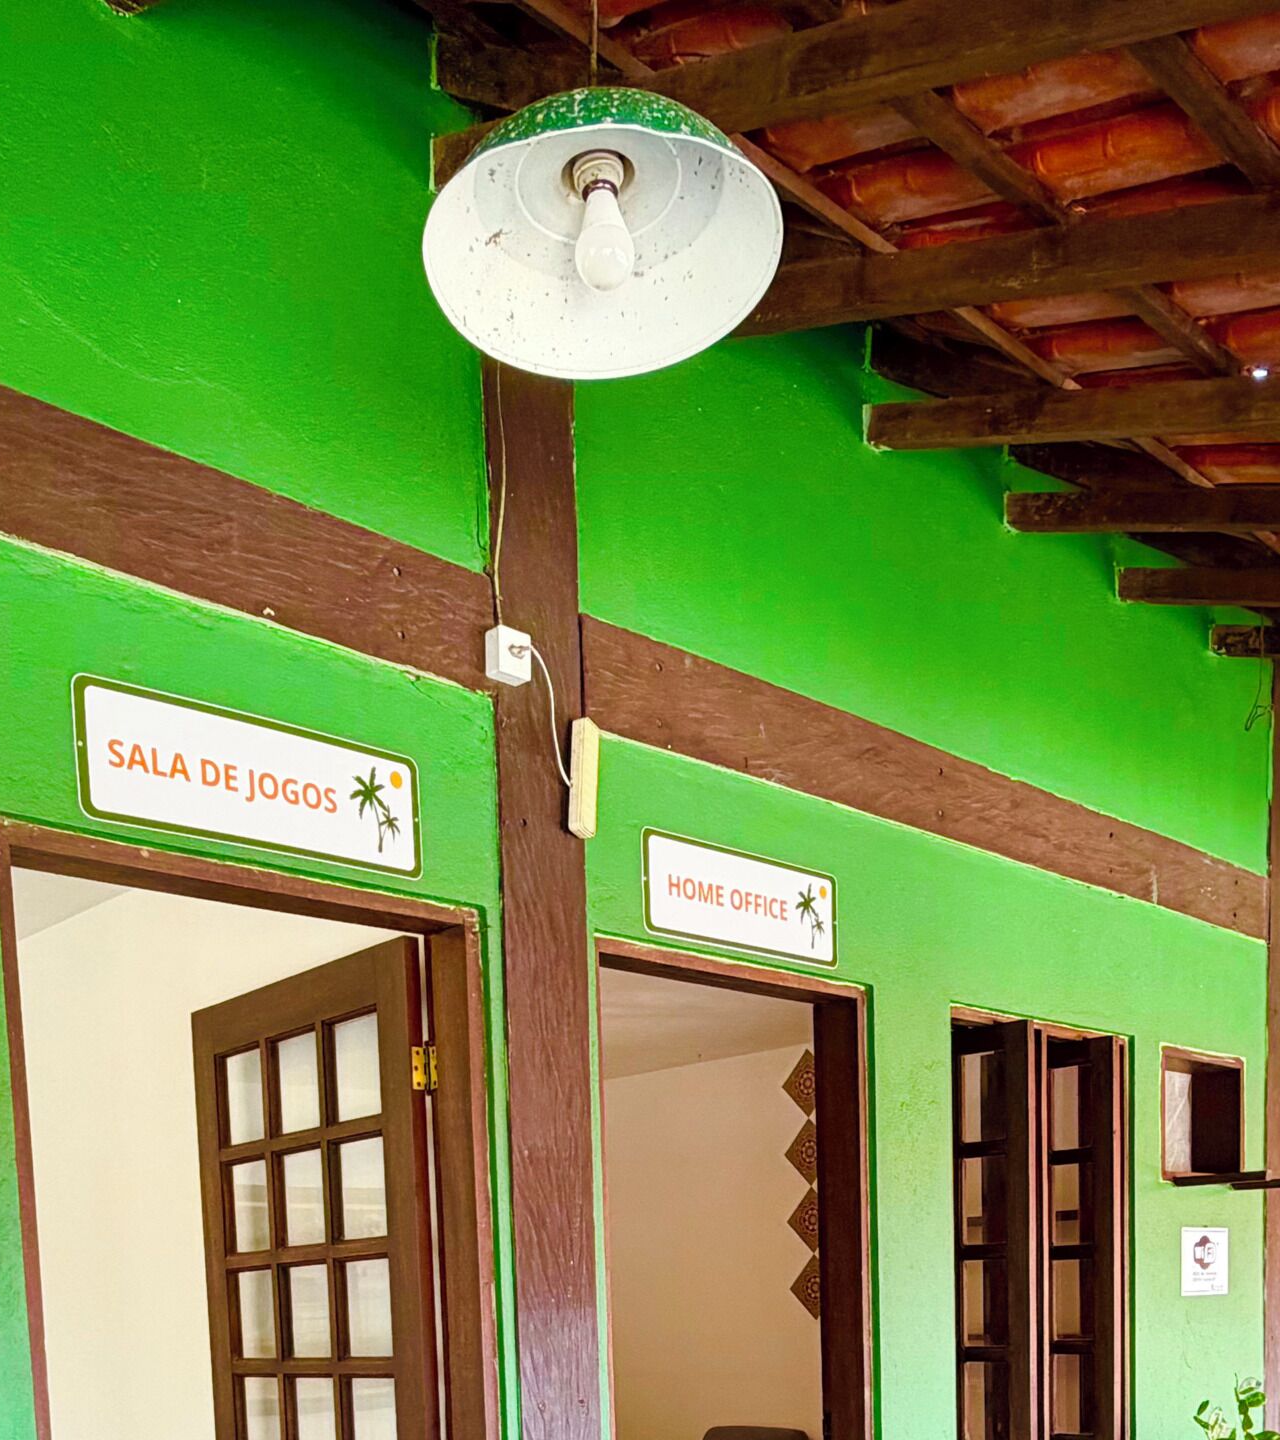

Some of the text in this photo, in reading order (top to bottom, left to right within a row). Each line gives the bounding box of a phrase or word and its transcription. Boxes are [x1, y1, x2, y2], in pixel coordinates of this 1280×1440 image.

[107, 738, 338, 814] SALA DE JOGOS
[668, 873, 788, 922] HOME OFFICE
